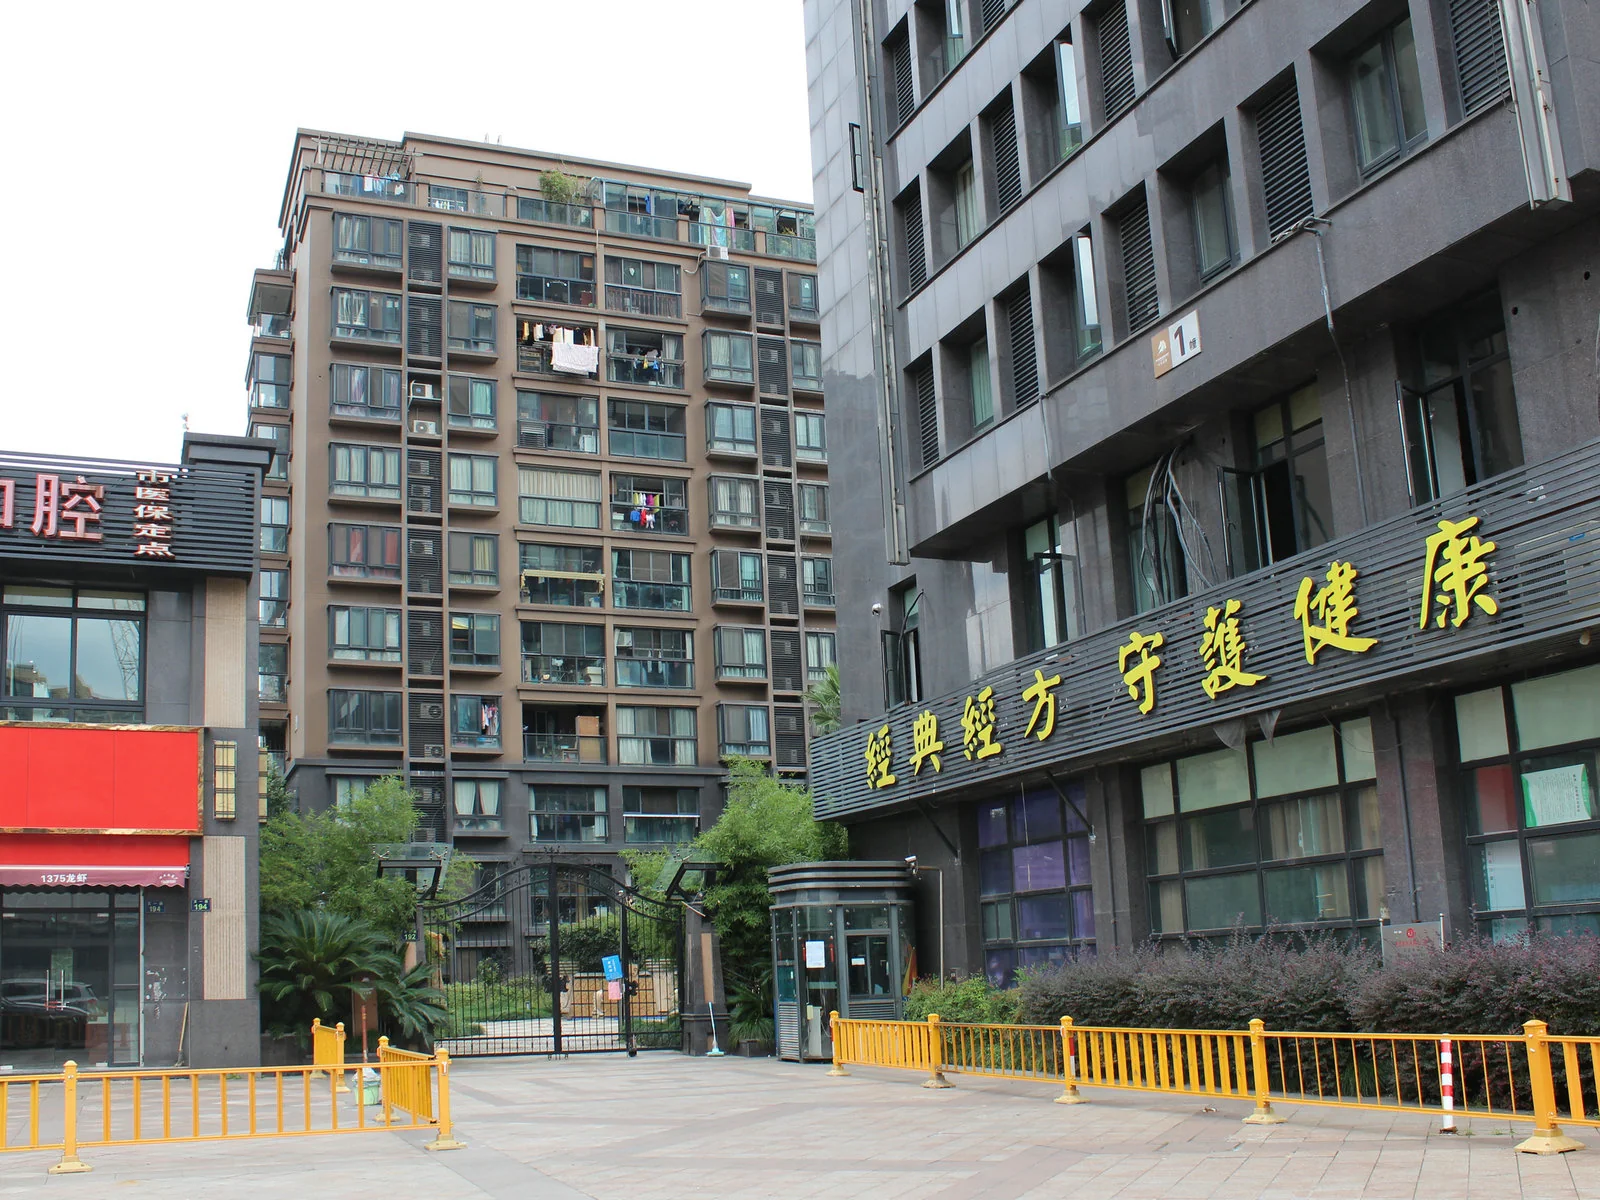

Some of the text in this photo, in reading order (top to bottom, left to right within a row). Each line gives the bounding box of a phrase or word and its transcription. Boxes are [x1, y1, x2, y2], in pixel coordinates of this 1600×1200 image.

[133, 469, 176, 559] 市医保定点
[40, 873, 88, 883] 1375龙虾
